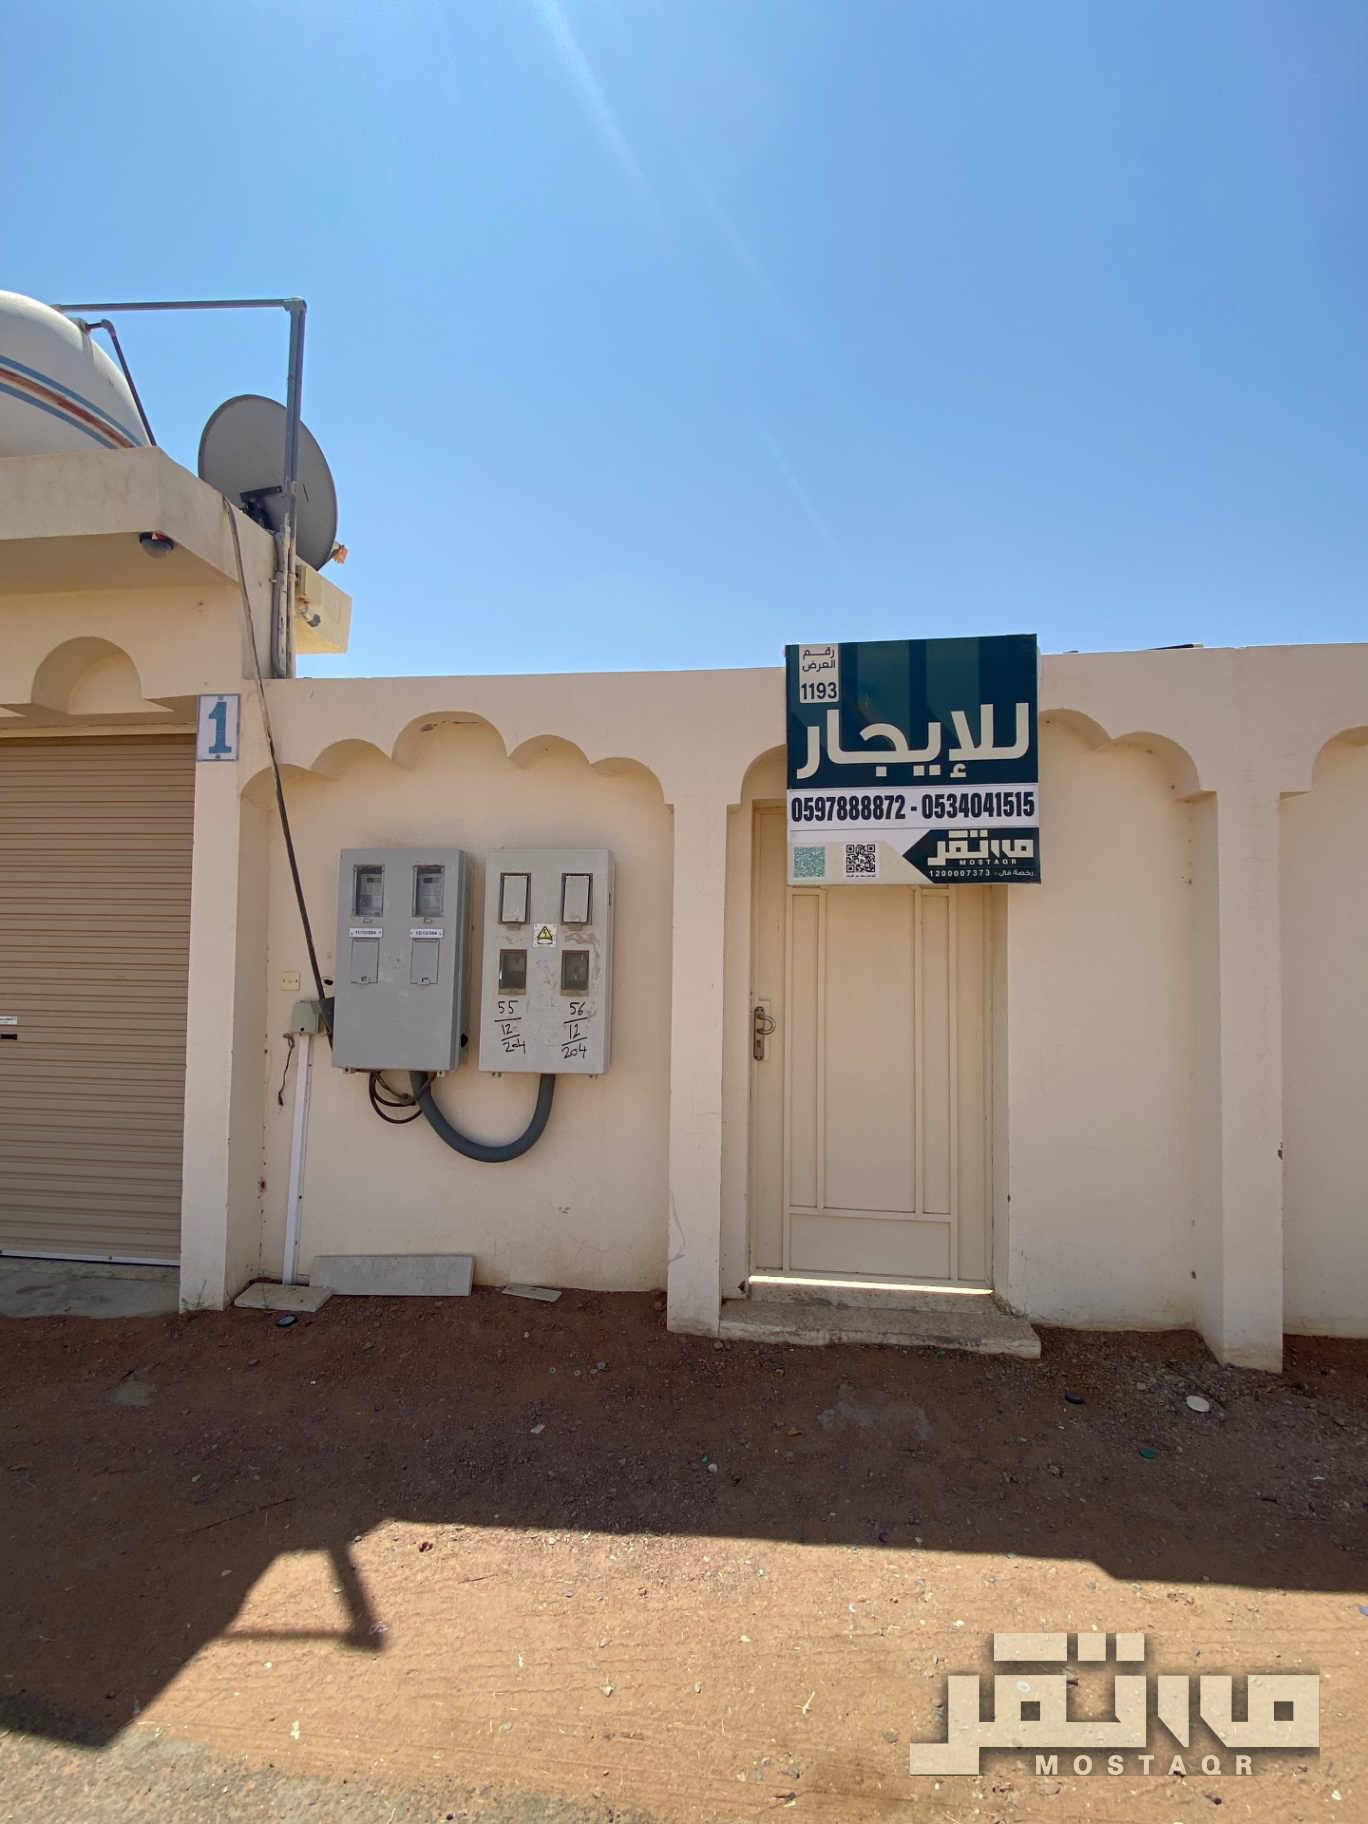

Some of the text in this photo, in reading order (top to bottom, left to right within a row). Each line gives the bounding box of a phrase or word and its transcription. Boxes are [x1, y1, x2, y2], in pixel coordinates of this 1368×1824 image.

[803, 646, 835, 660] رقم
[802, 659, 836, 673] العرض
[801, 681, 838, 700] 1193
[208, 701, 232, 754] 1
[796, 702, 1030, 780] للإيجار
[791, 794, 907, 823] 0597888872
[921, 790, 1036, 819] 0534041515
[959, 858, 1017, 866] MOSTAQR
[928, 868, 991, 878] 1200007373
[997, 868, 1034, 878] رخصة فال
[497, 1000, 518, 1015] 55
[569, 1001, 586, 1016] 56
[501, 1023, 513, 1036] 12
[569, 1023, 581, 1040] 12
[502, 1038, 526, 1055] 204
[561, 1042, 588, 1060] 204
